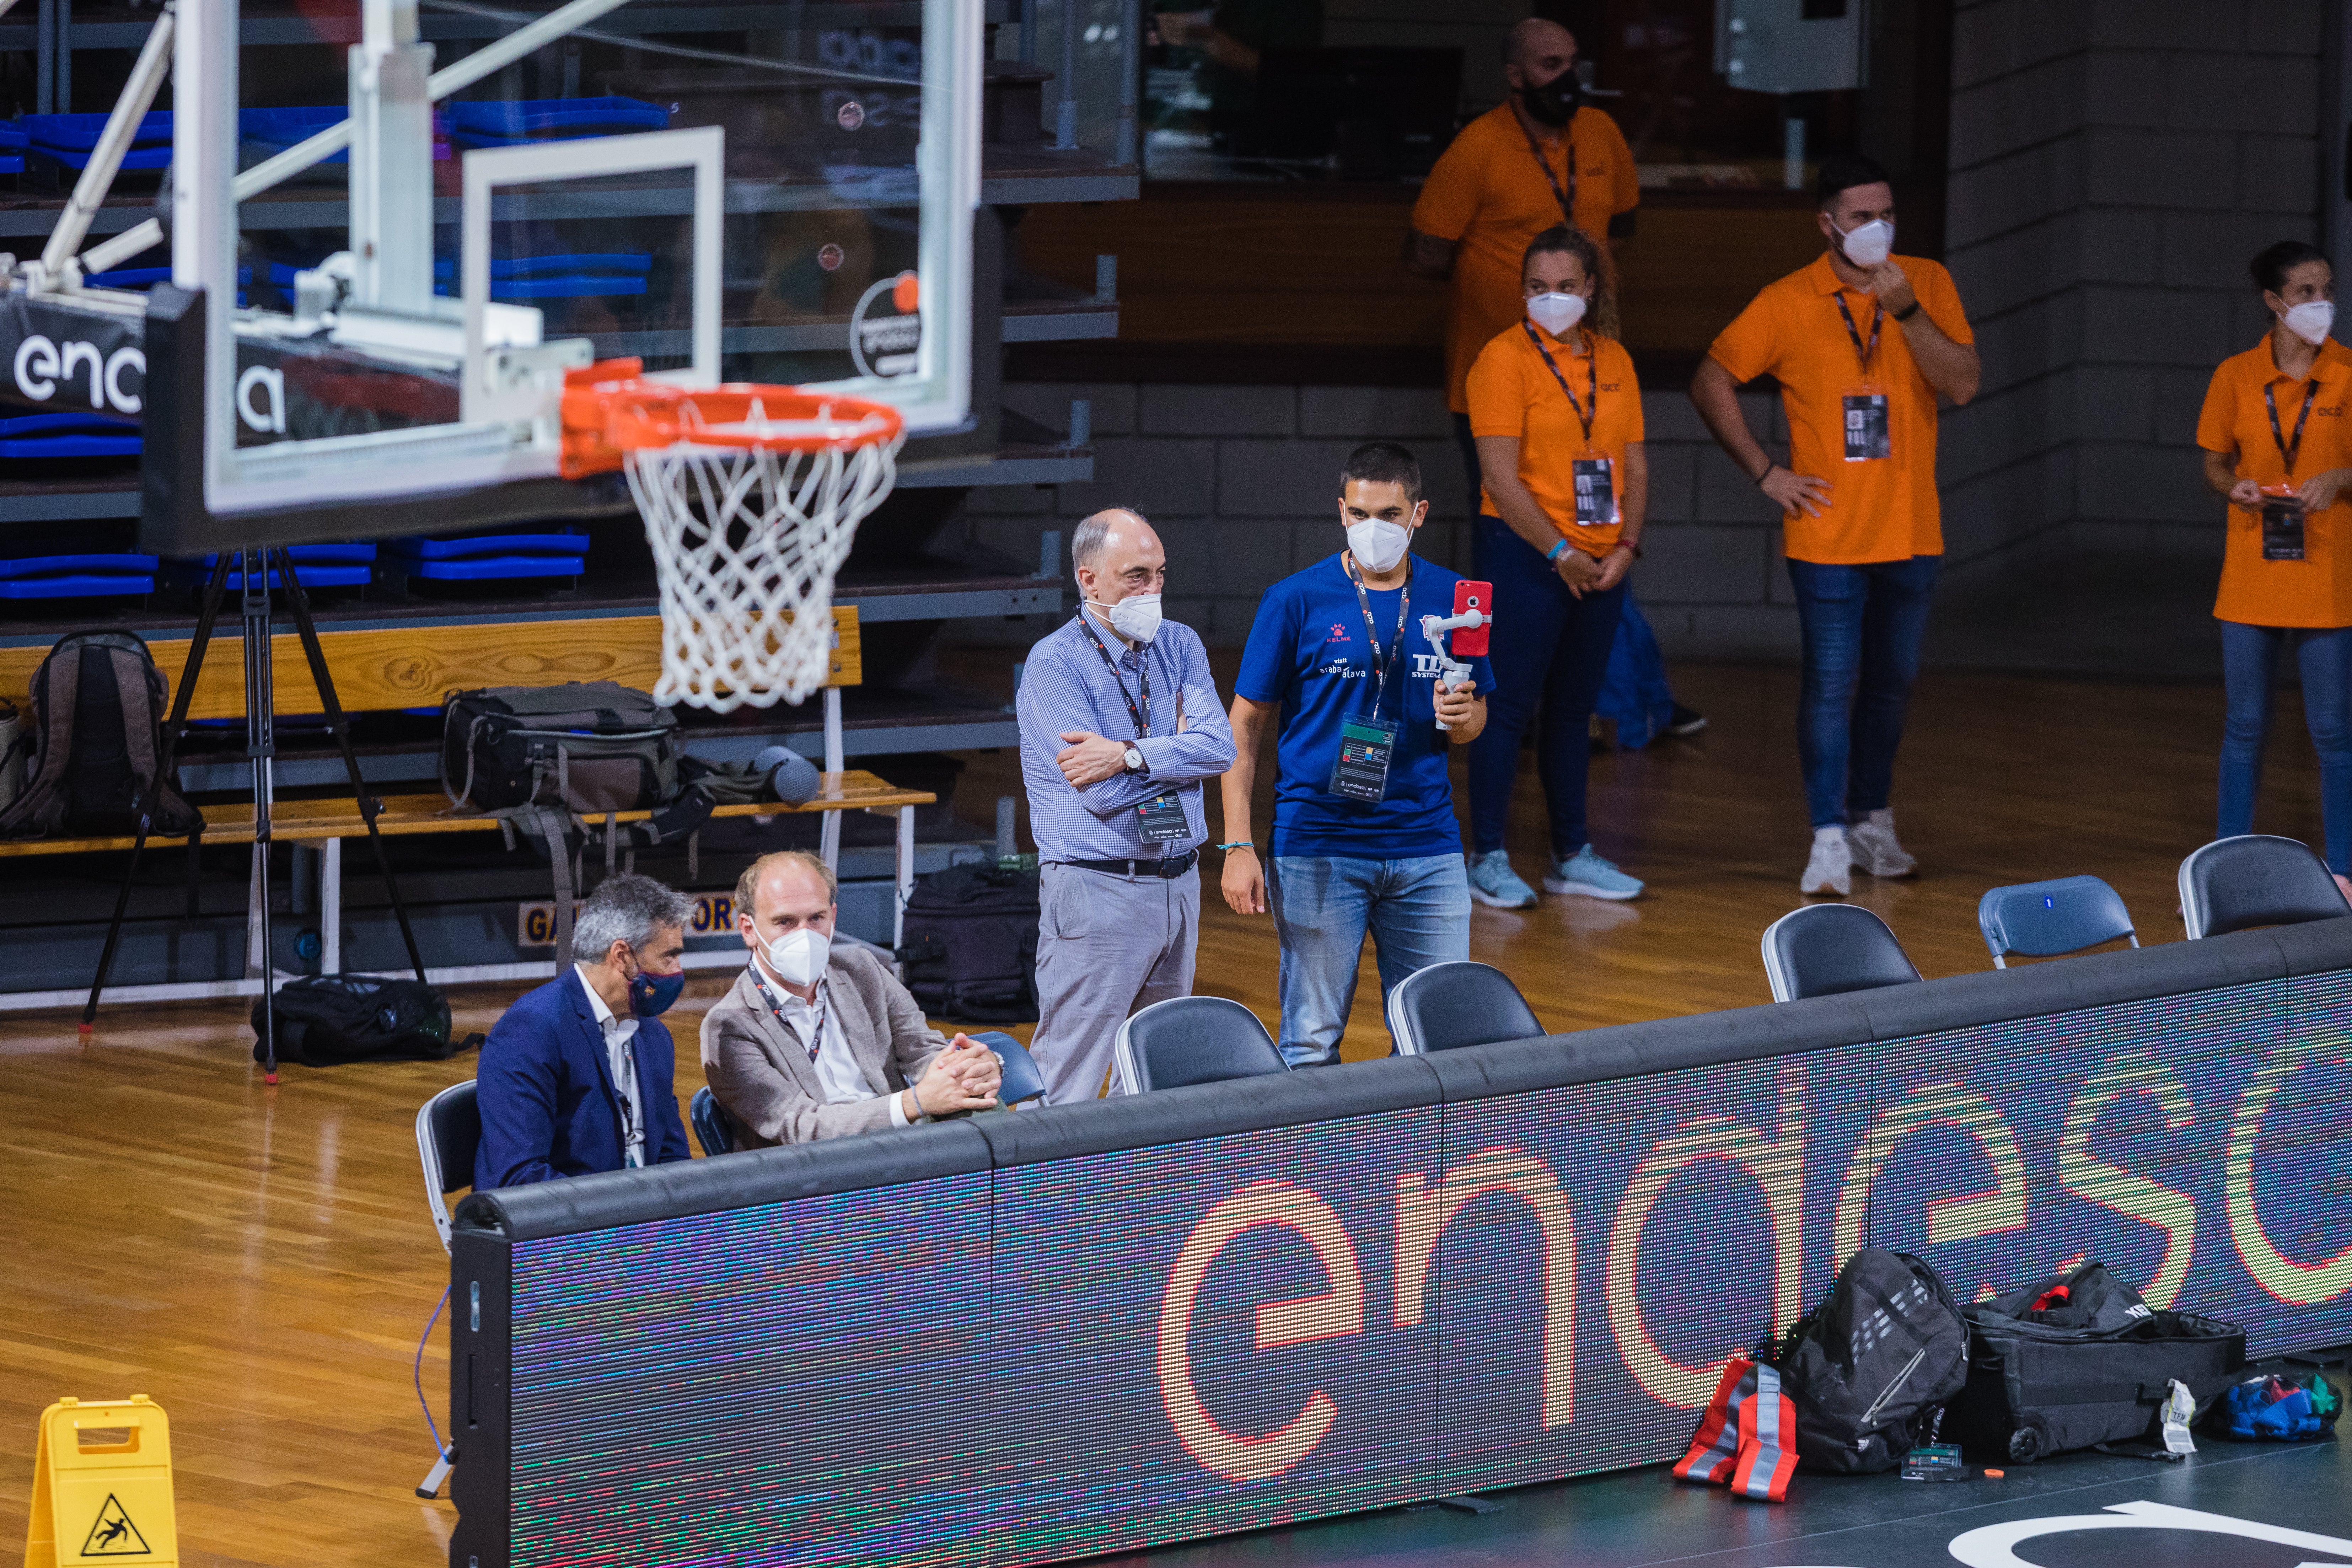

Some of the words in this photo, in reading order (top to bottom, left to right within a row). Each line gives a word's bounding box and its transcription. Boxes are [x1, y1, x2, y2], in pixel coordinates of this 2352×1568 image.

[1090, 638, 1099, 648] acb
[1107, 662, 1116, 673] acb
[1320, 665, 1342, 673] araba
[1342, 667, 1365, 678] álava
[2046, 898, 2051, 907] 1
[2173, 1411, 2186, 1421] TFN
